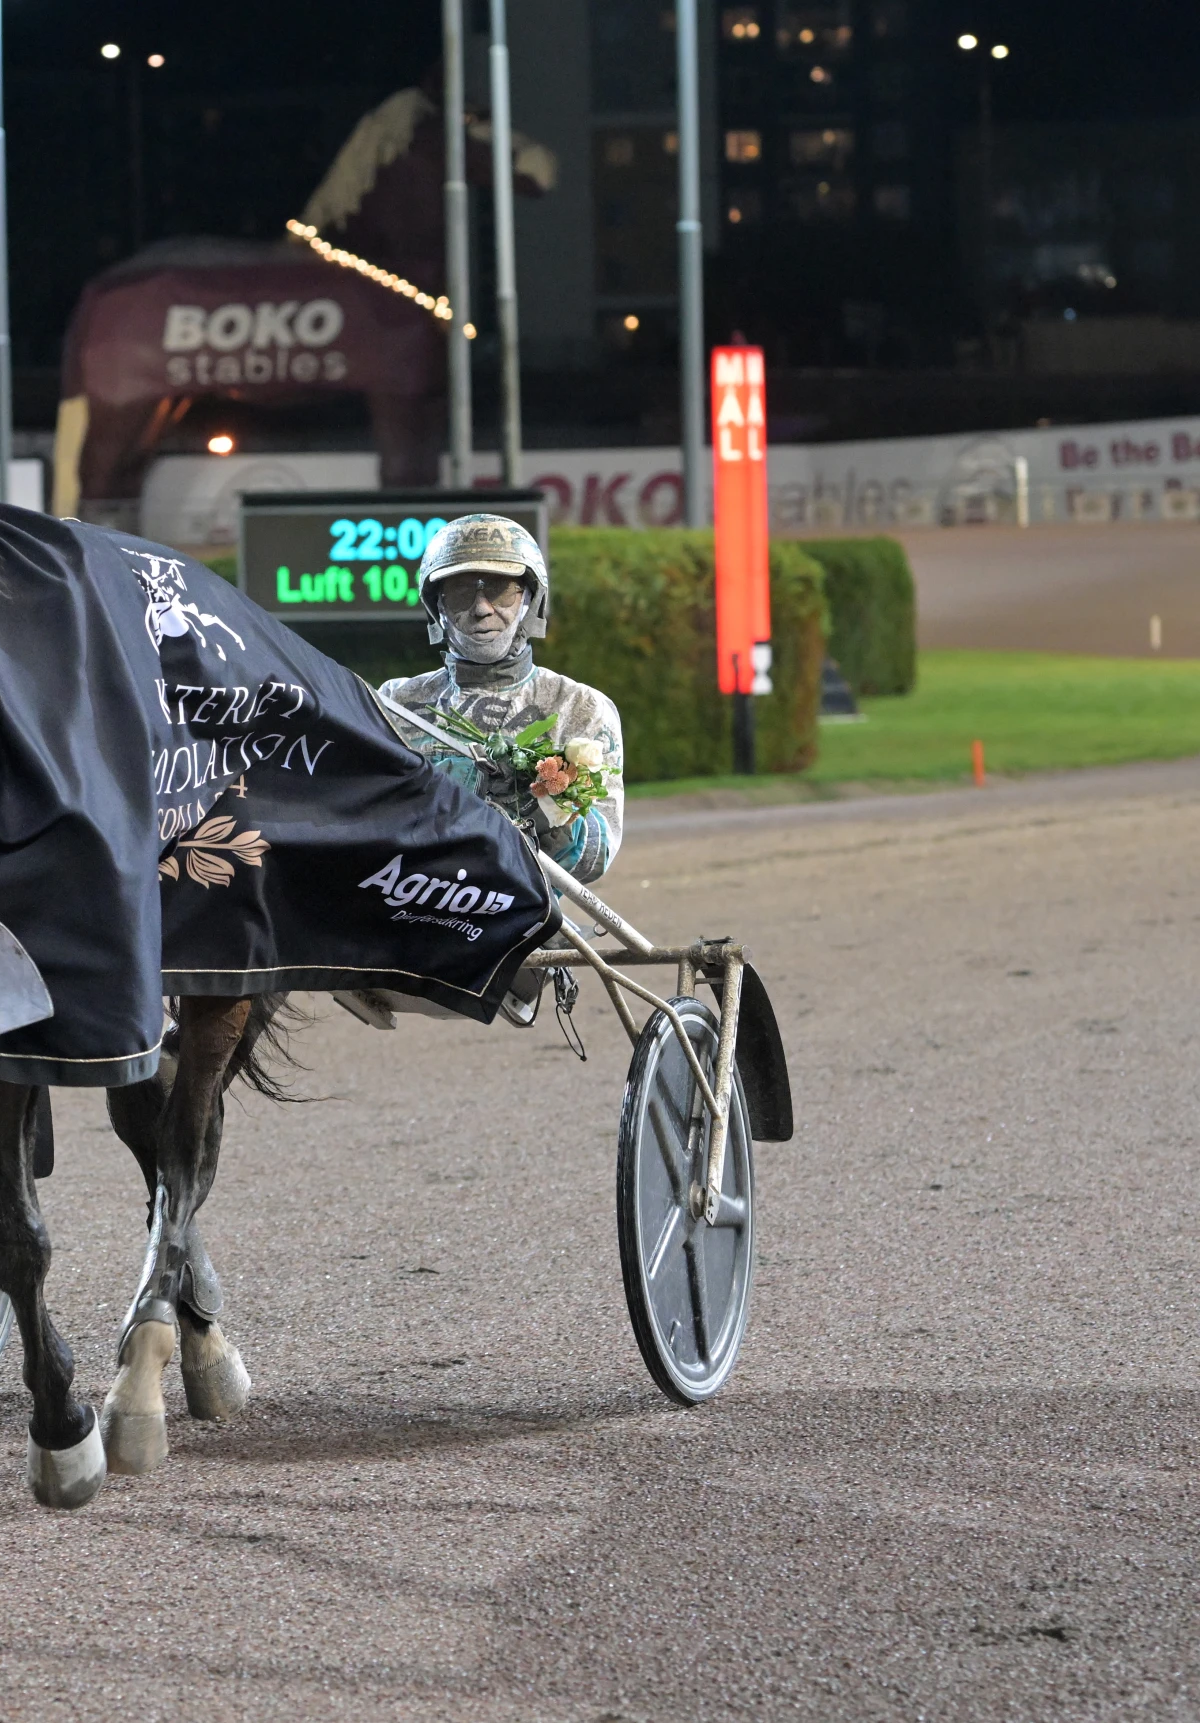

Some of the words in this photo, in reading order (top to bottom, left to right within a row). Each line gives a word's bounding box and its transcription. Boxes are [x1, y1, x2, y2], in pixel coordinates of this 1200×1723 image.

[164, 299, 343, 352] BOKO
[167, 350, 347, 387] stables
[472, 471, 684, 527] OKO
[277, 566, 355, 603] Luft
[362, 565, 420, 607] 10,
[359, 854, 482, 914] Agria
